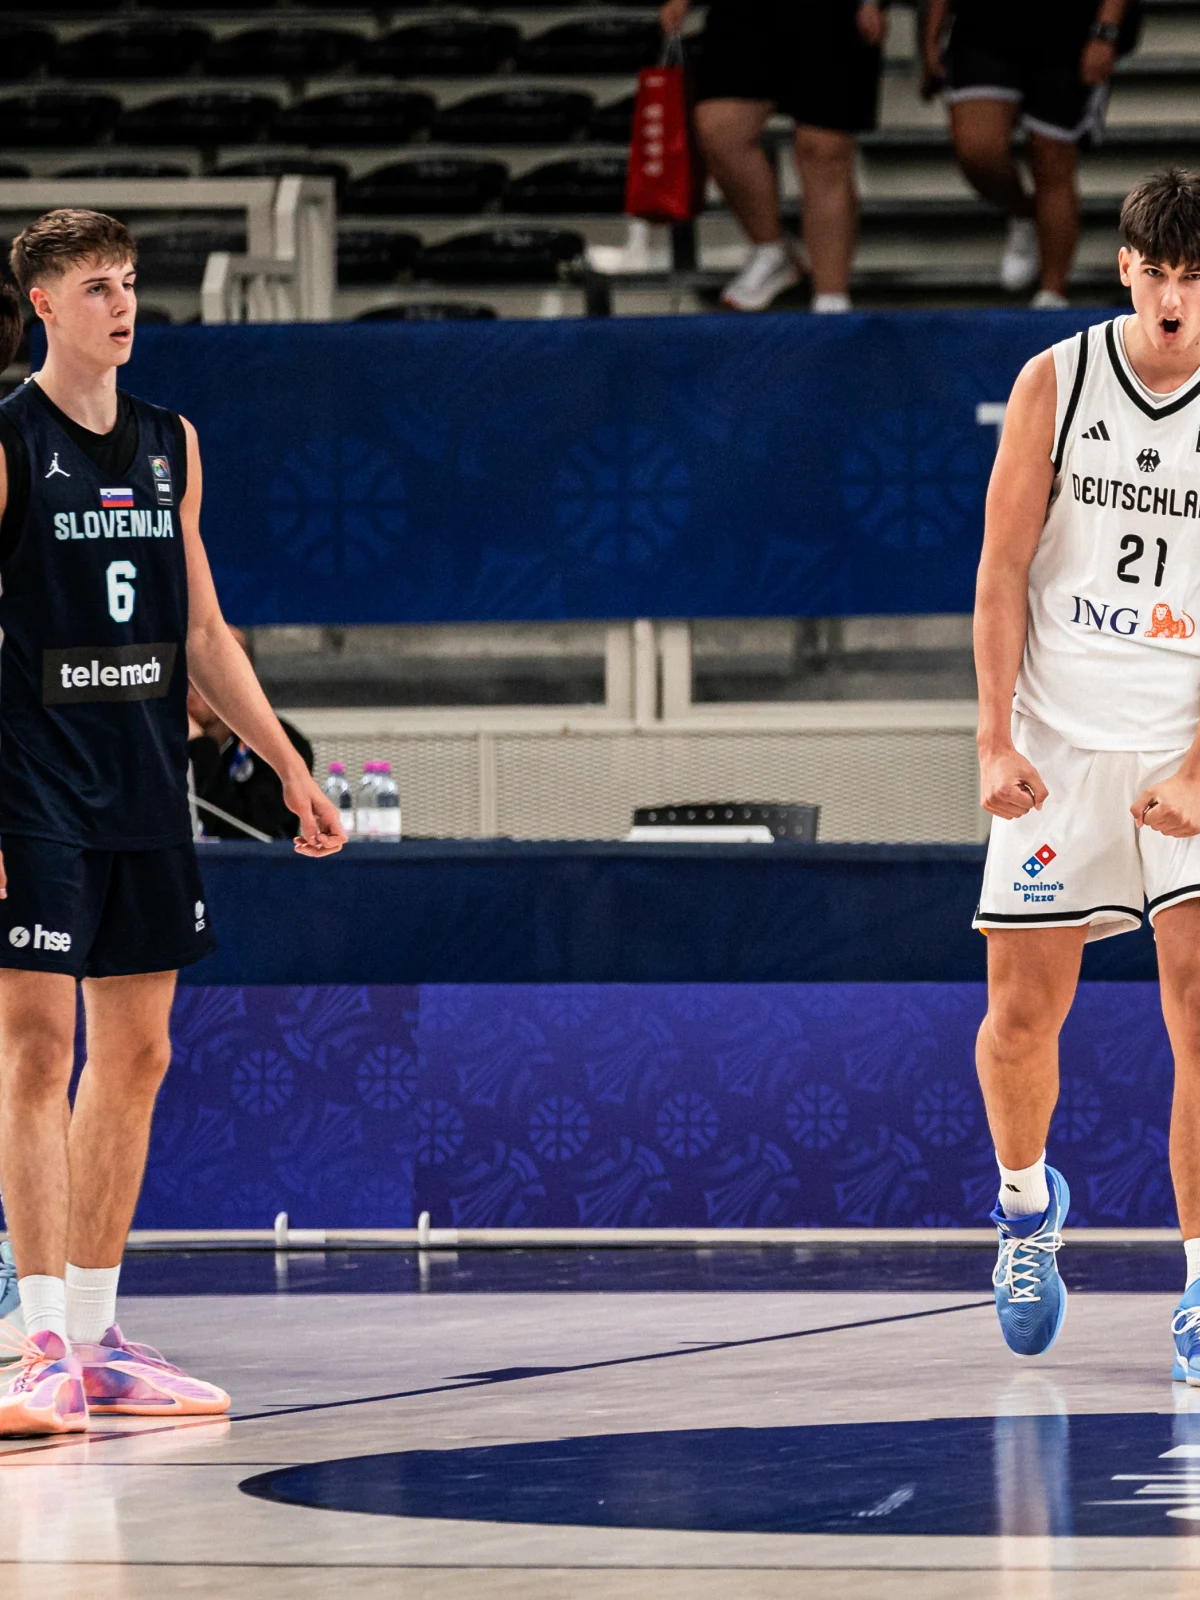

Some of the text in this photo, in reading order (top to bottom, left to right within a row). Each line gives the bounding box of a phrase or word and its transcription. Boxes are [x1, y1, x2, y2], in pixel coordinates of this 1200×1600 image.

[53, 509, 174, 541] SLOVENIJA
[1116, 533, 1168, 588] 21
[105, 559, 138, 623] 6
[1069, 595, 1140, 636] ING
[1013, 881, 1065, 892] Domino's
[1023, 892, 1055, 903] Pizza
[33, 924, 72, 953] hse
